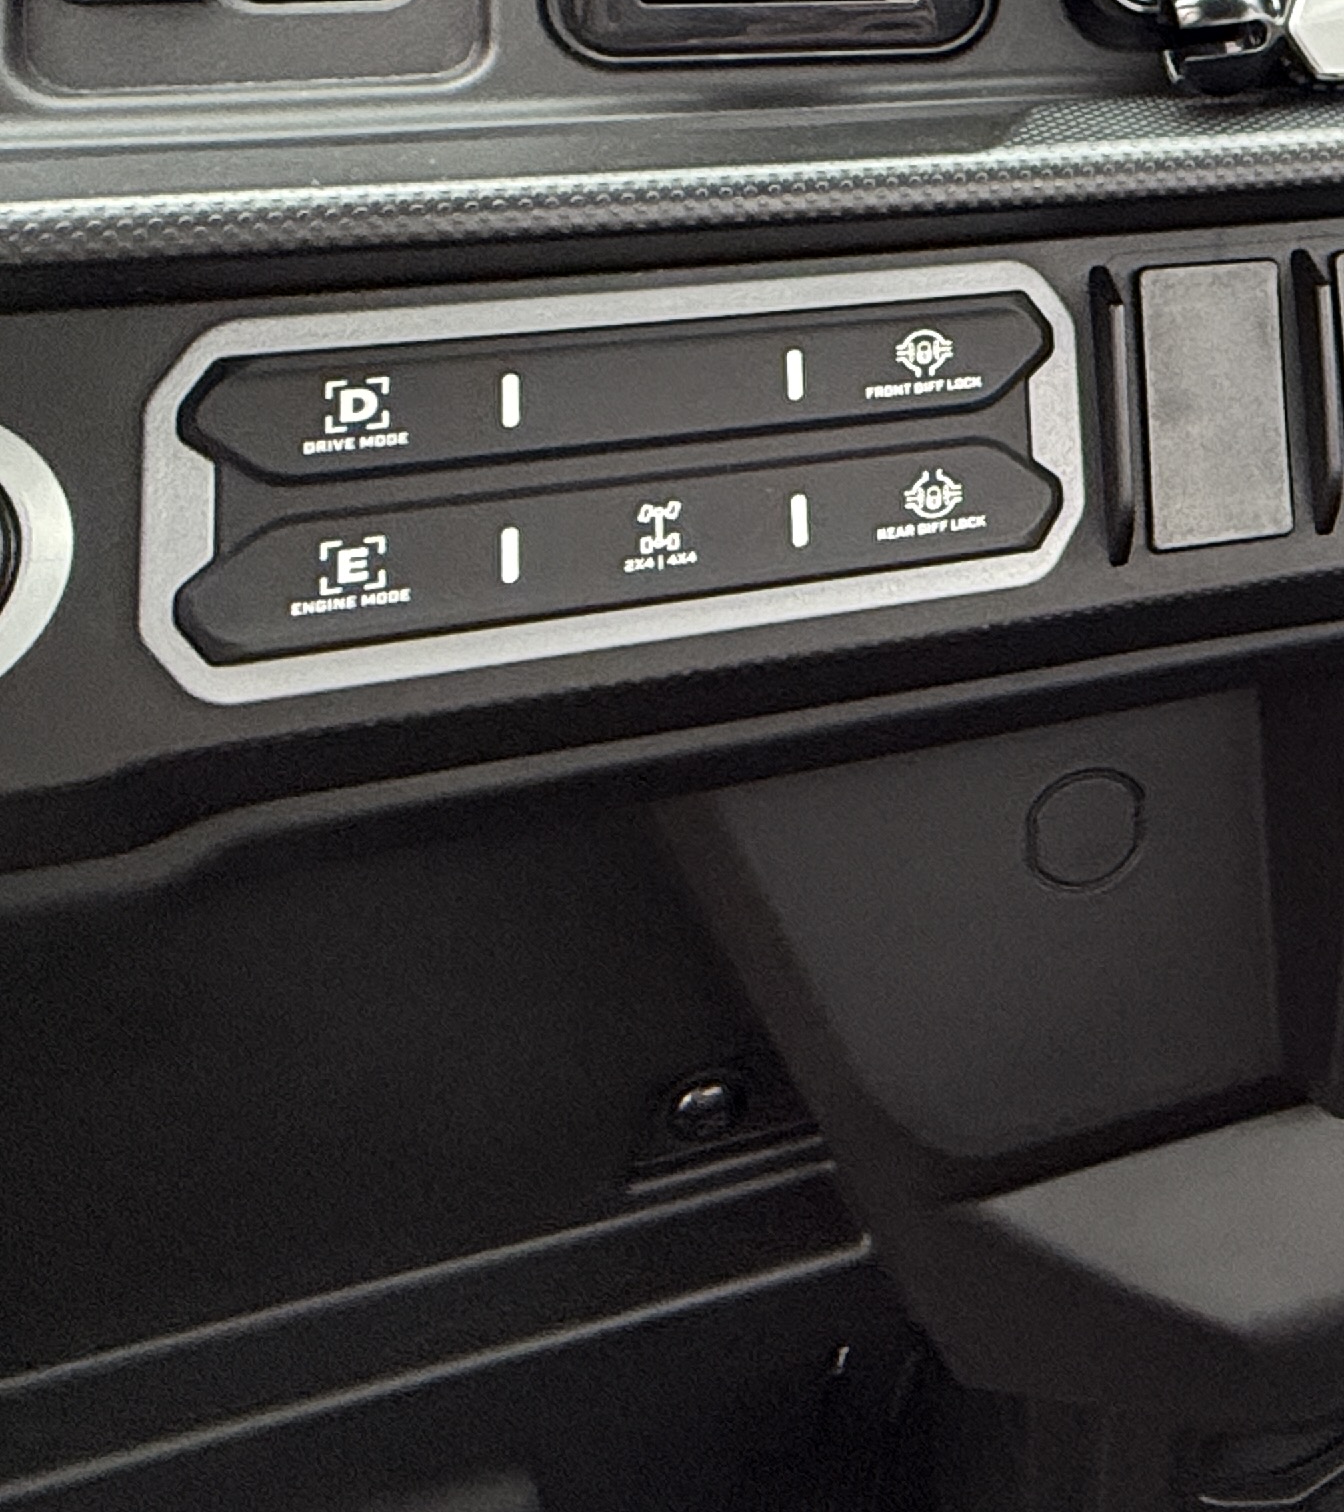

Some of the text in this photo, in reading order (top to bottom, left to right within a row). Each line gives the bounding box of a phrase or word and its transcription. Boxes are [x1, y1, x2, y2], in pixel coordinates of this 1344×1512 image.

[865, 382, 912, 400] FRONT
[946, 375, 983, 392] LOCK
[339, 387, 379, 424] D
[302, 430, 410, 456] DRIVE MODE
[950, 514, 988, 532] LOCK
[336, 546, 370, 584] E
[290, 587, 412, 618] ENGINE MODE
